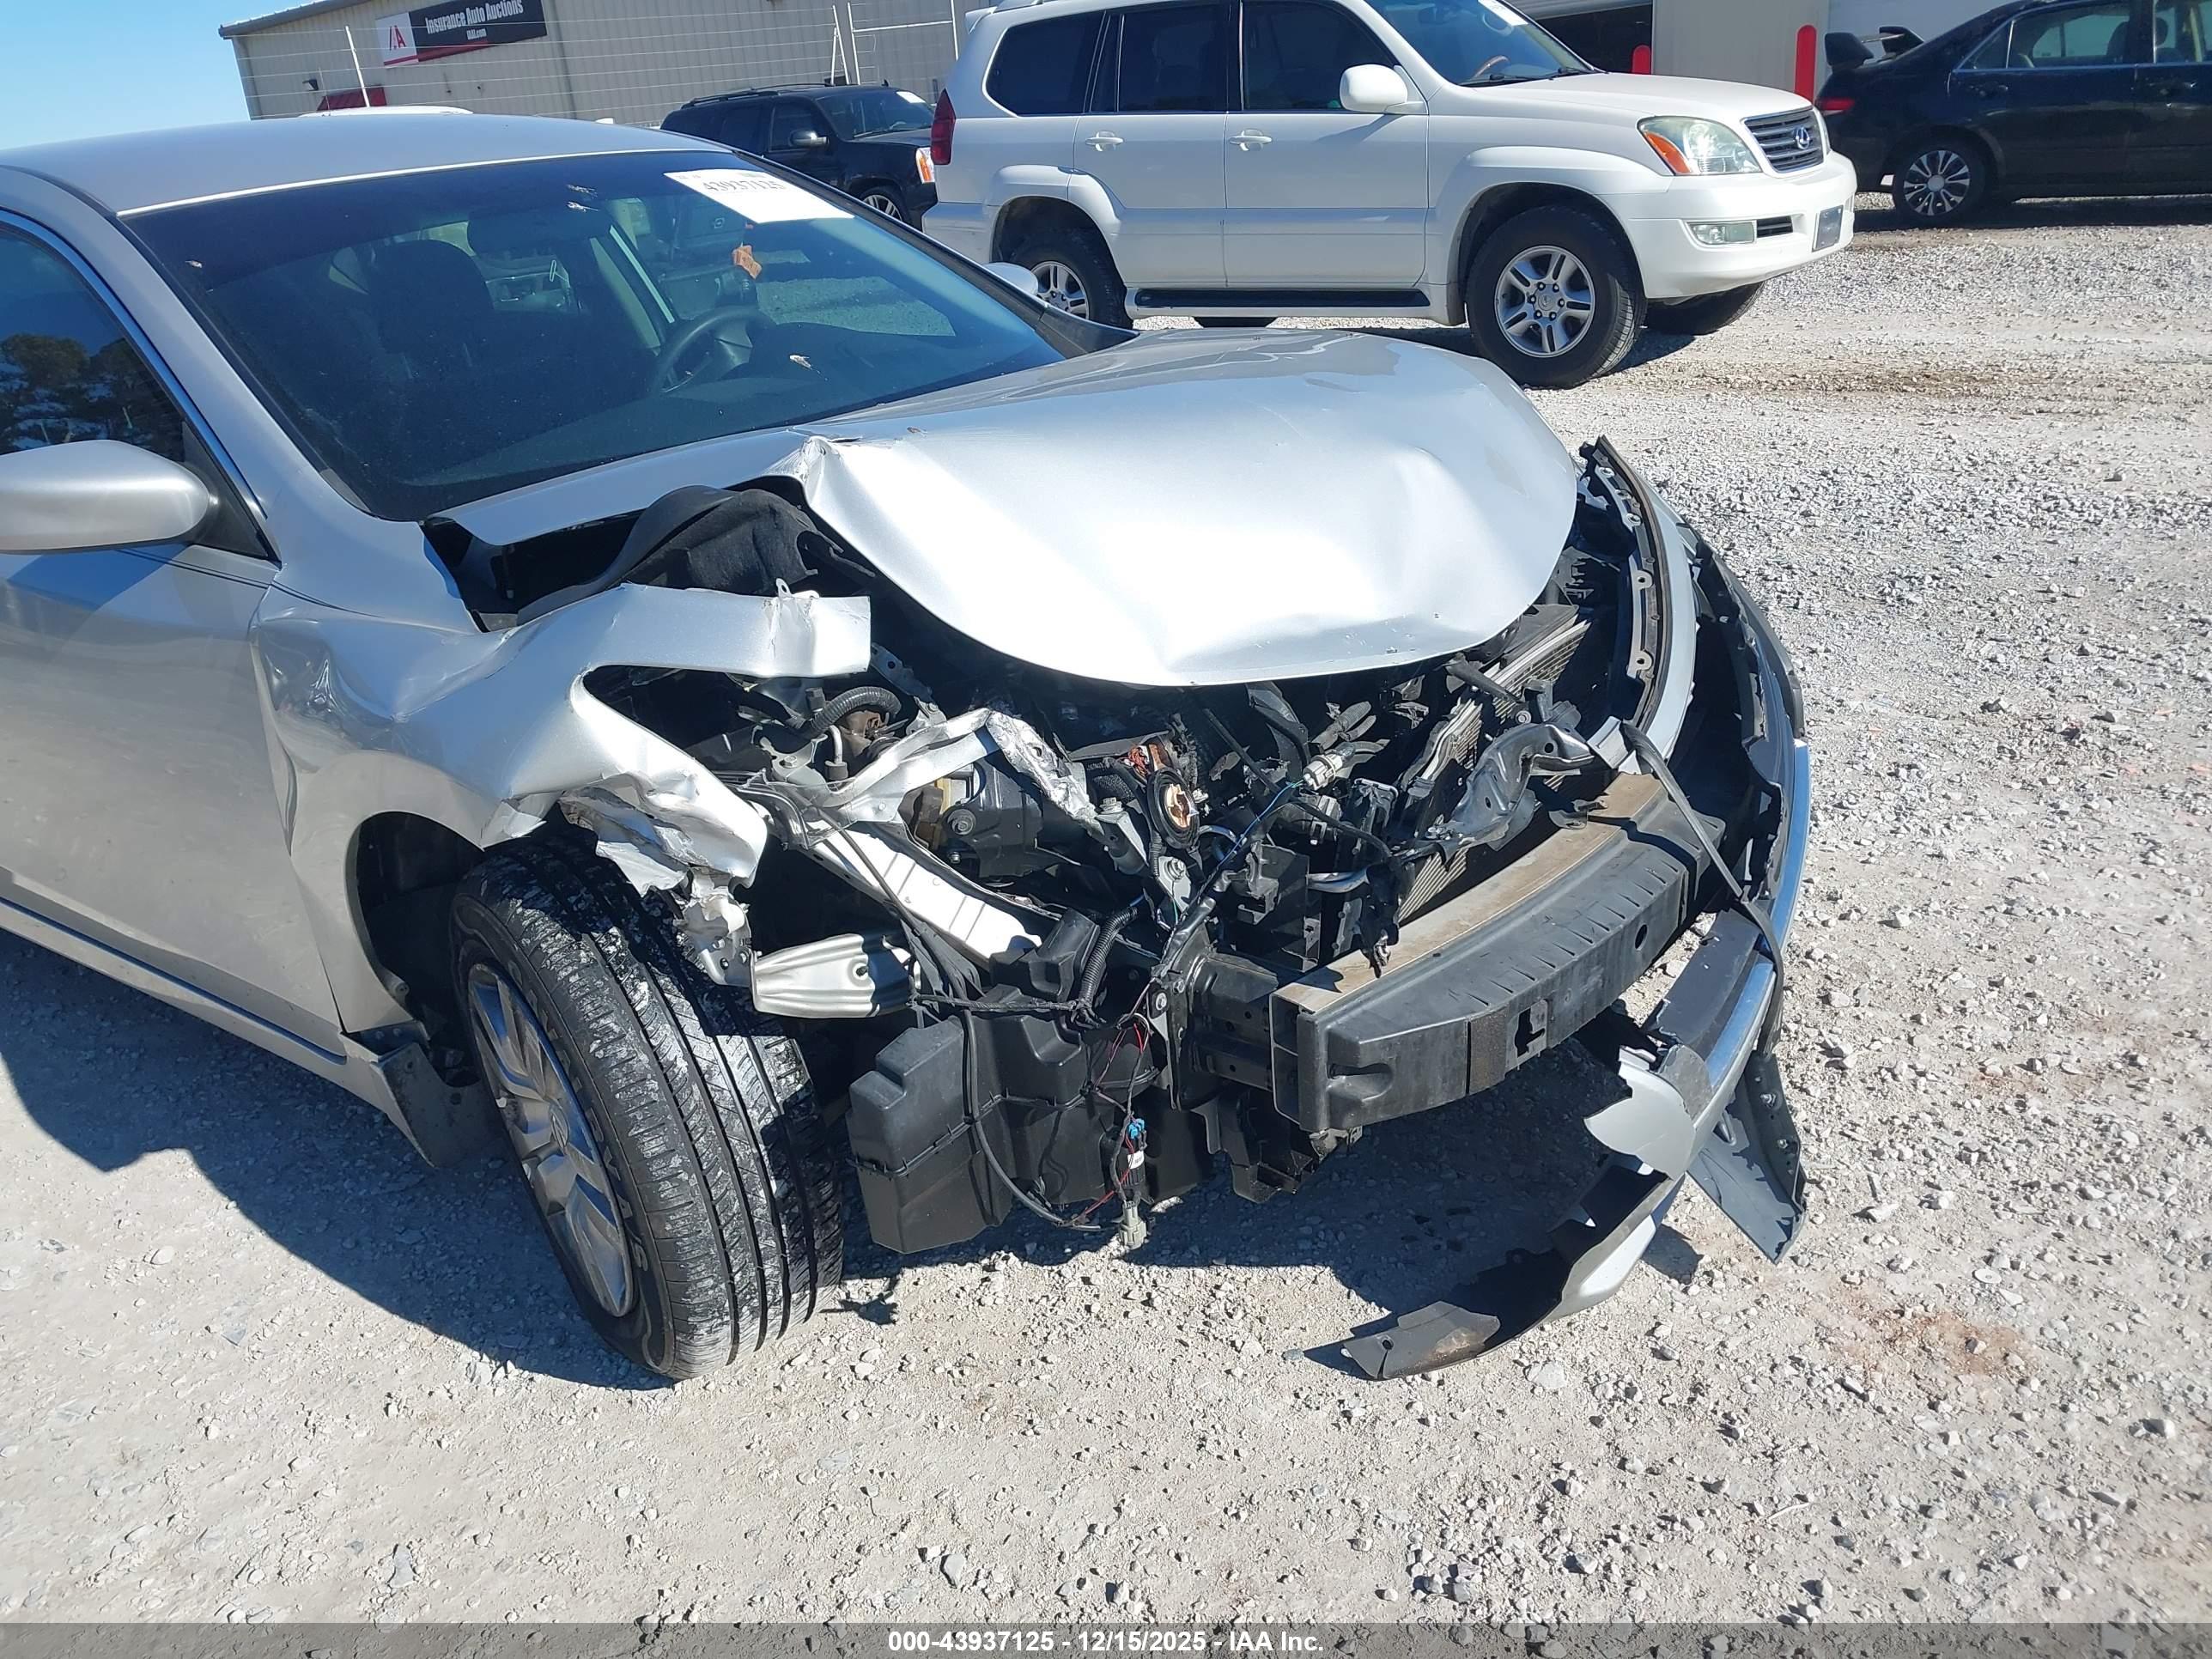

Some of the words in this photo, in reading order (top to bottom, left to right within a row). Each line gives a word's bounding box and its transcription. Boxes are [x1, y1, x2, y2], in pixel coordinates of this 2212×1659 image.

[425, 12, 466, 34] Insurance
[465, 6, 486, 25] Auto
[485, 0, 524, 21] Auctions
